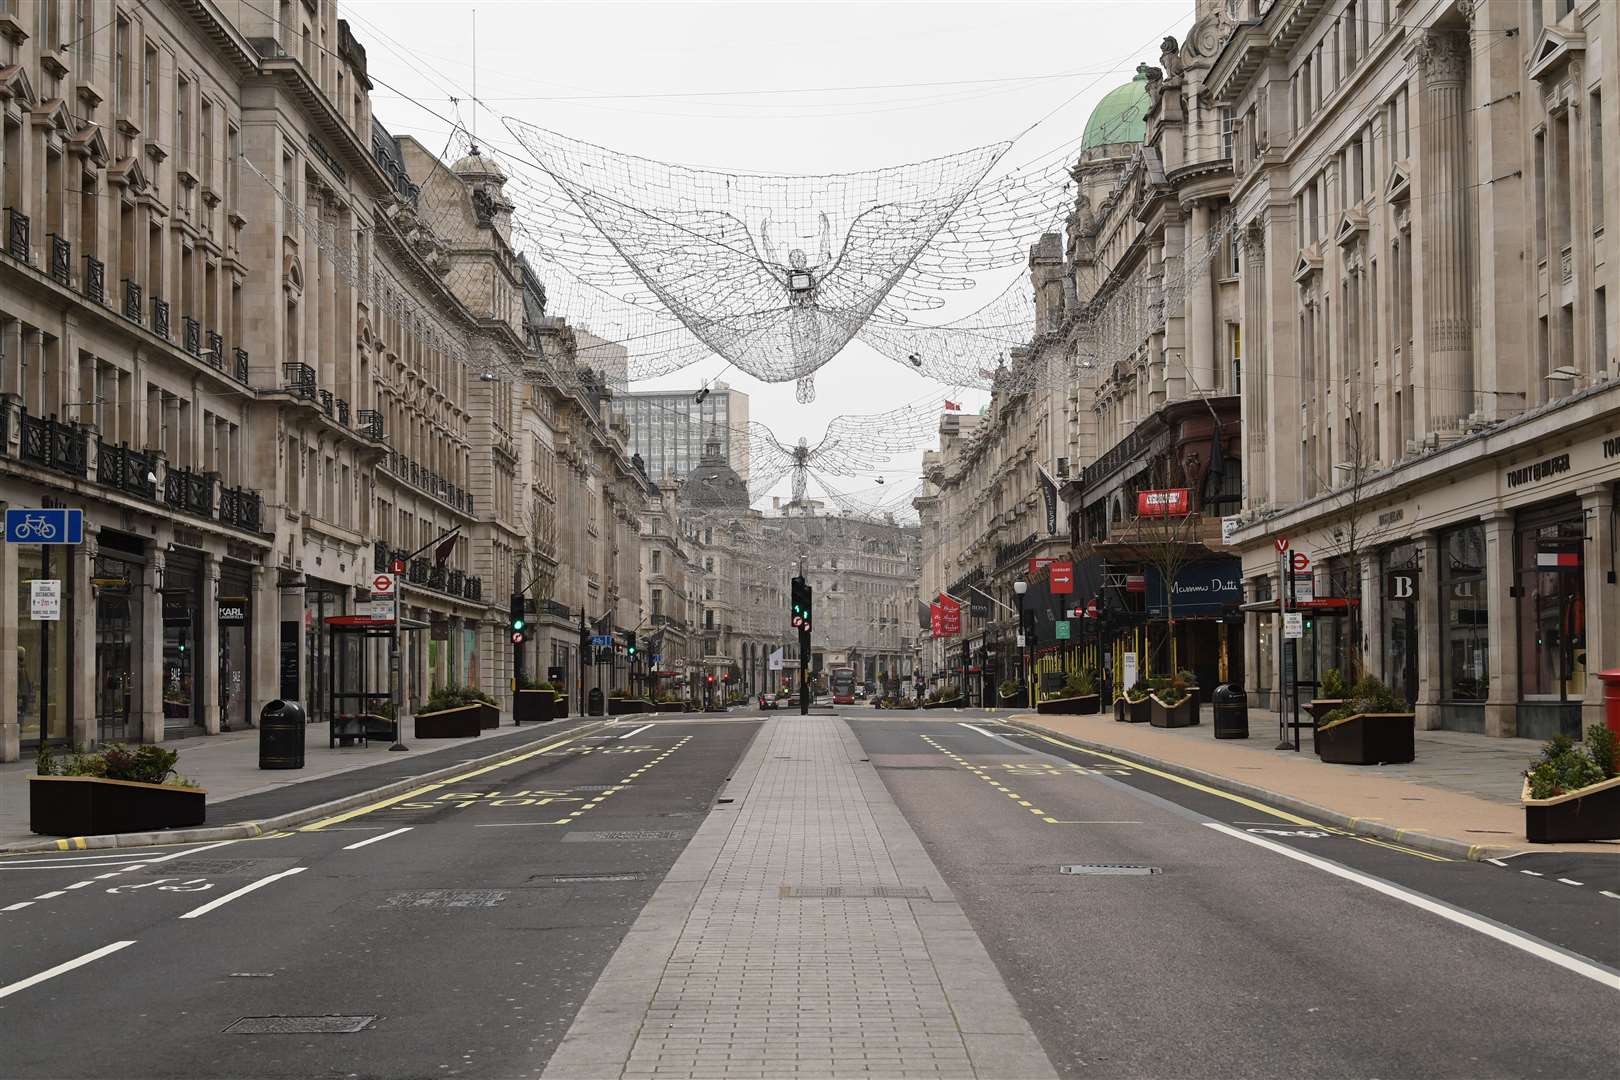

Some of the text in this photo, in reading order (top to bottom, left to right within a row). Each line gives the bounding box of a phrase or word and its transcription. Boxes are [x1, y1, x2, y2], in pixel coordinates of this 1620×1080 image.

[1507, 465, 1533, 488] TOMMY
[1277, 539, 1287, 550] V
[395, 562, 401, 571] L
[1211, 578, 1238, 592] Dutti
[1393, 576, 1413, 598] B
[219, 607, 243, 616] KARL
[436, 789, 574, 800] BUS
[390, 797, 585, 810] STOP
